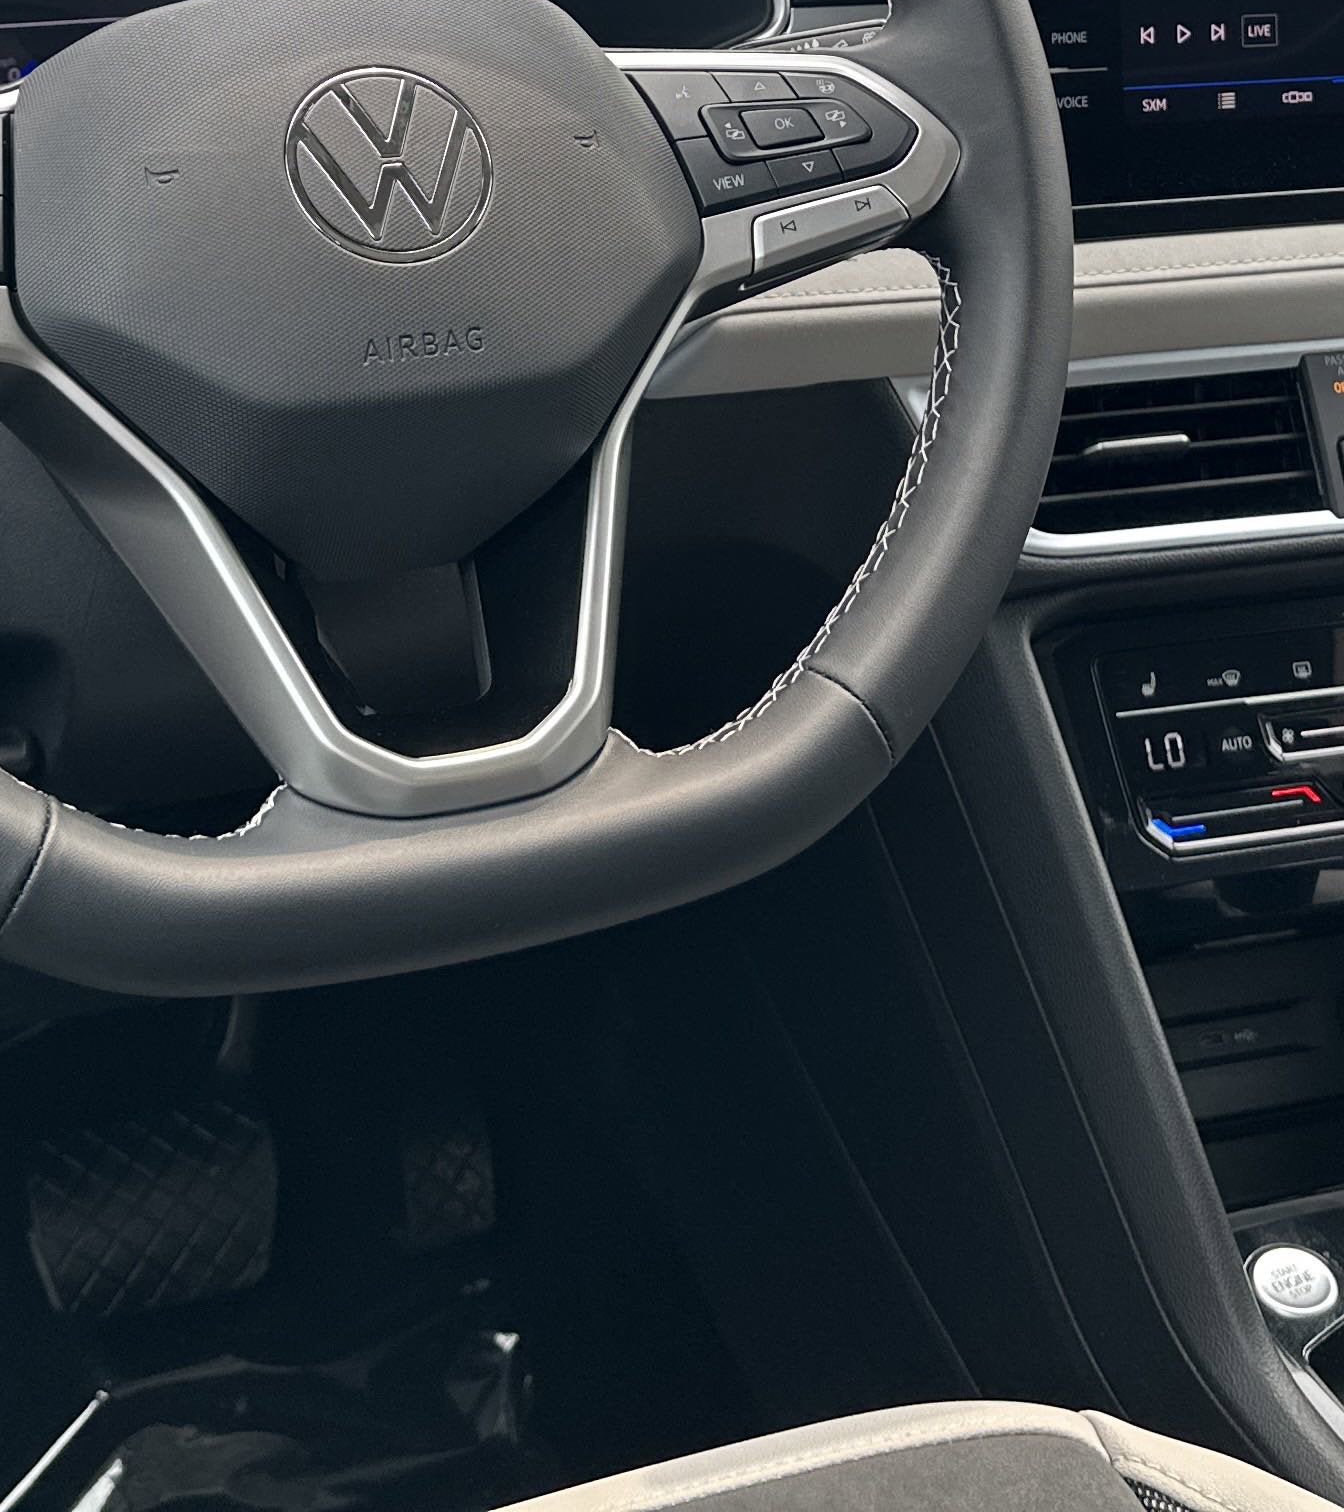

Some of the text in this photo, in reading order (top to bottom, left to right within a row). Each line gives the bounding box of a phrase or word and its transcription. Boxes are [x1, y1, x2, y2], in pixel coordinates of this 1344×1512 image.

[1050, 30, 1088, 45] PHONE
[1247, 23, 1272, 39] LIVE
[1056, 95, 1089, 110] VOICE
[1141, 97, 1169, 113] SXM
[774, 116, 795, 130] OK
[712, 173, 746, 191] VIEW
[362, 326, 486, 367] AIRBAG
[1144, 731, 1186, 772] LO
[1220, 735, 1253, 753] AUTO
